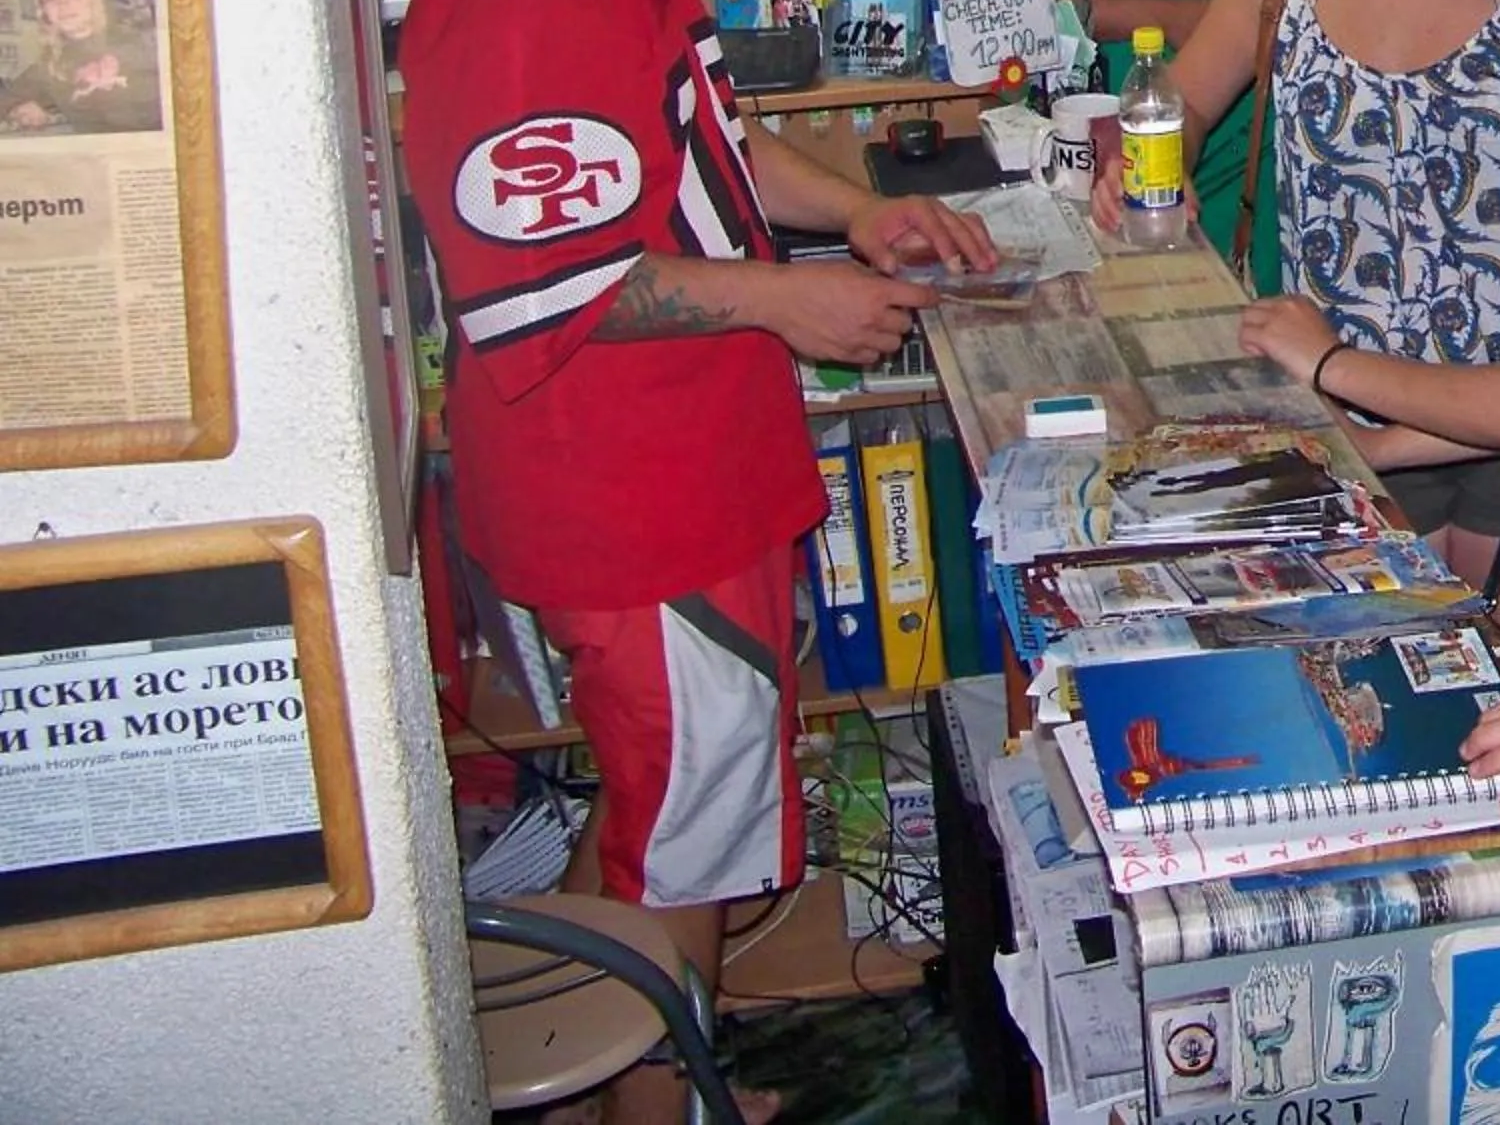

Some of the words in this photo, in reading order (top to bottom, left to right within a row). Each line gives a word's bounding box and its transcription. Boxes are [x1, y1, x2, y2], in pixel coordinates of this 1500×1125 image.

[834, 20, 904, 46] CITY
[965, 10, 1023, 34] TIME:
[134, 667, 189, 699] ас
[46, 718, 108, 749] на
[123, 695, 304, 741] морето
